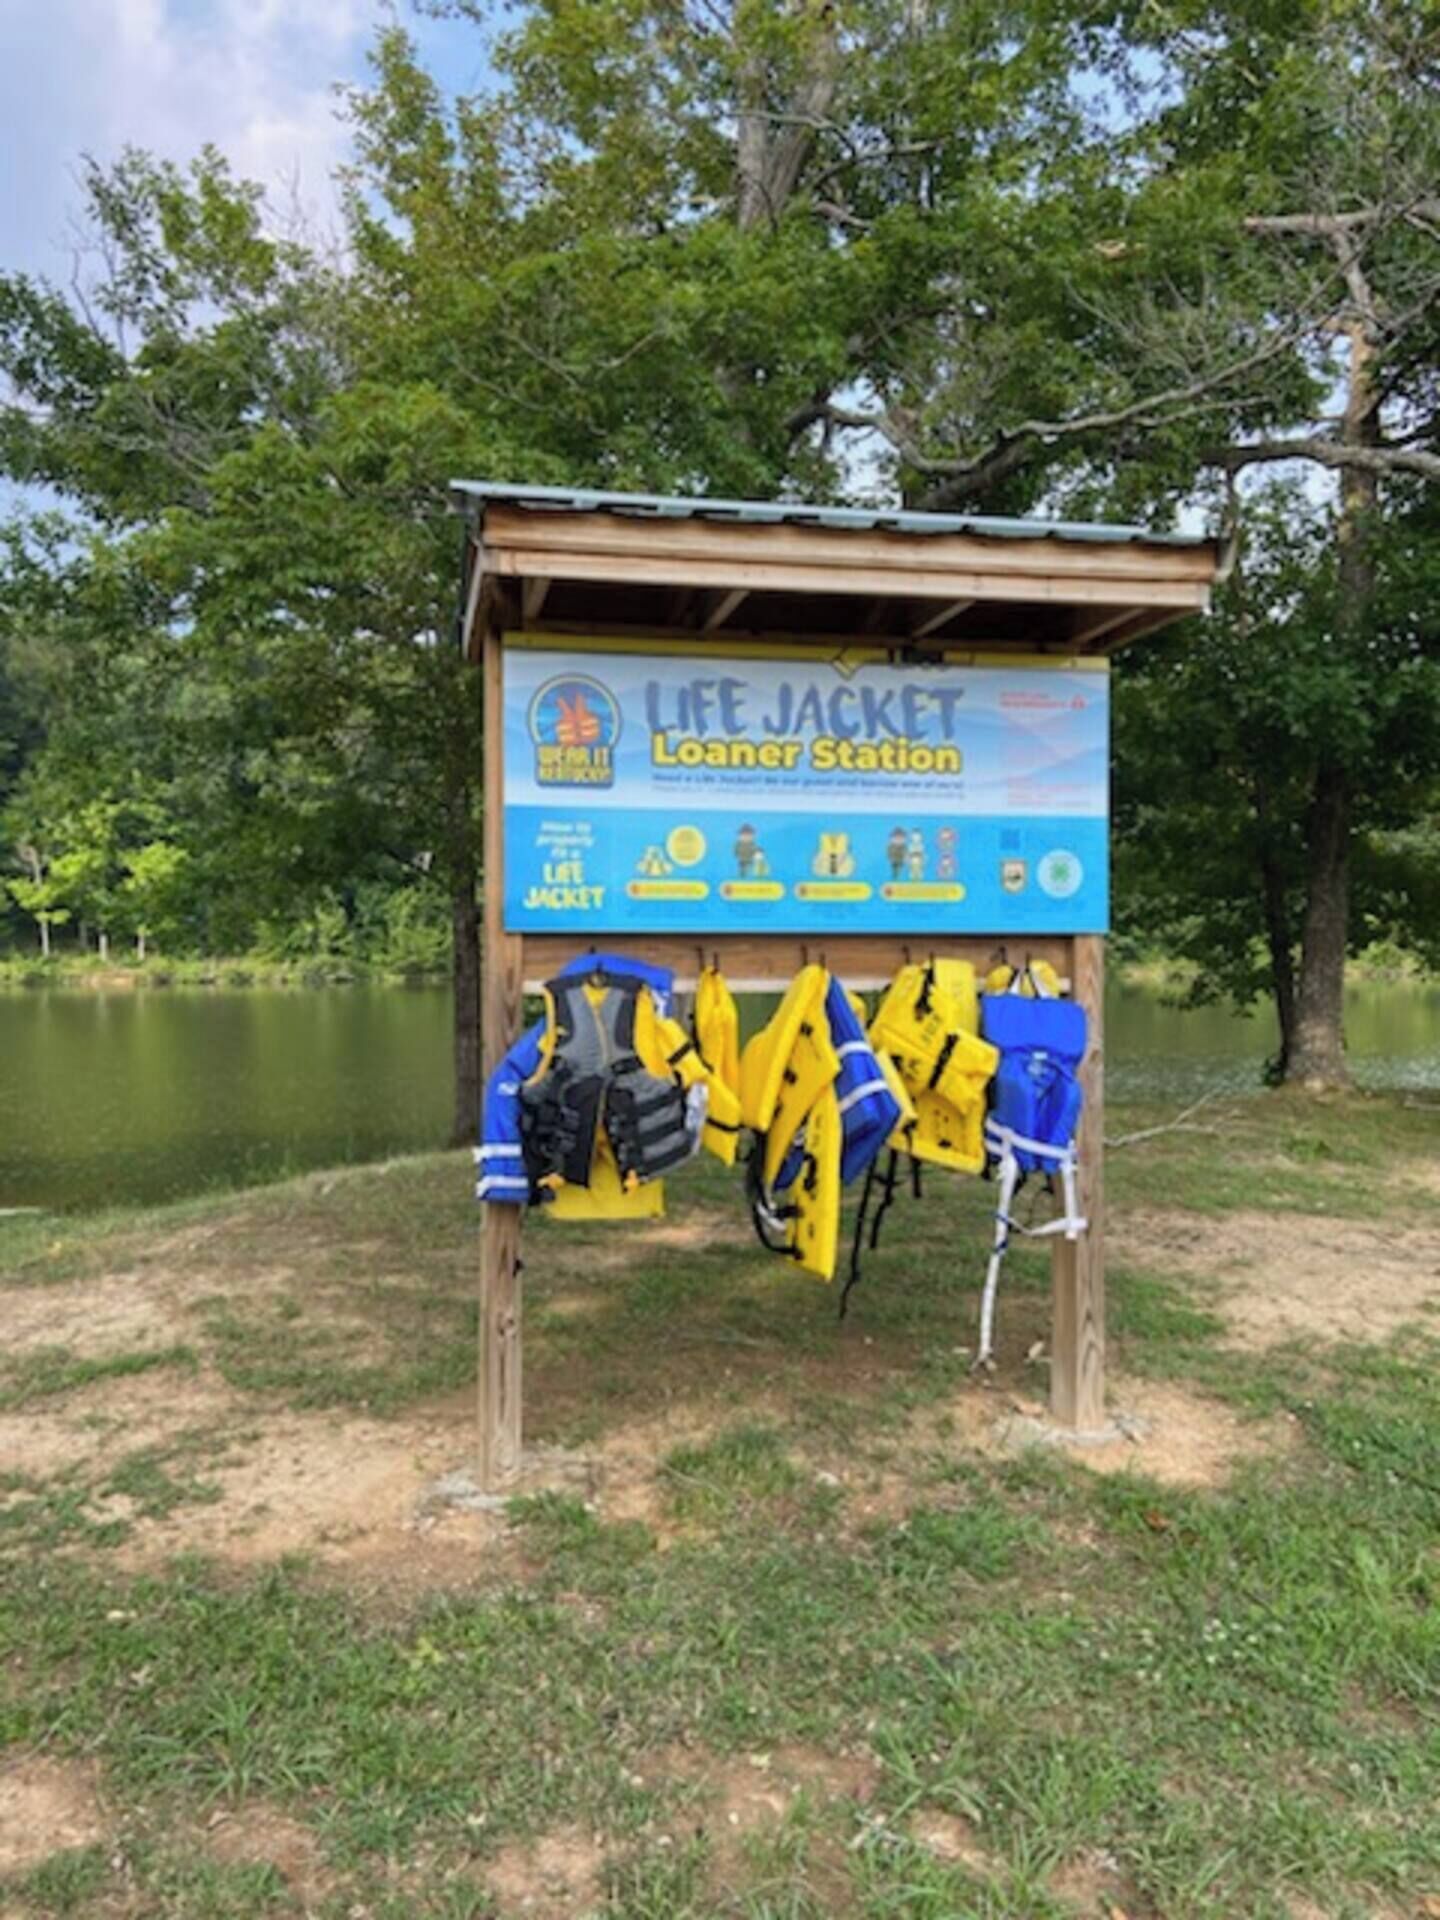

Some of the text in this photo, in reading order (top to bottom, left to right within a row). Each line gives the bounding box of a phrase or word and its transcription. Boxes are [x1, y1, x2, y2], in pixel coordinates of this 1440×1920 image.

[645, 677, 964, 740] LIFE JACKET
[652, 733, 962, 774] Loaner Station
[543, 860, 583, 885] LIFE
[523, 885, 605, 909] JACKET
